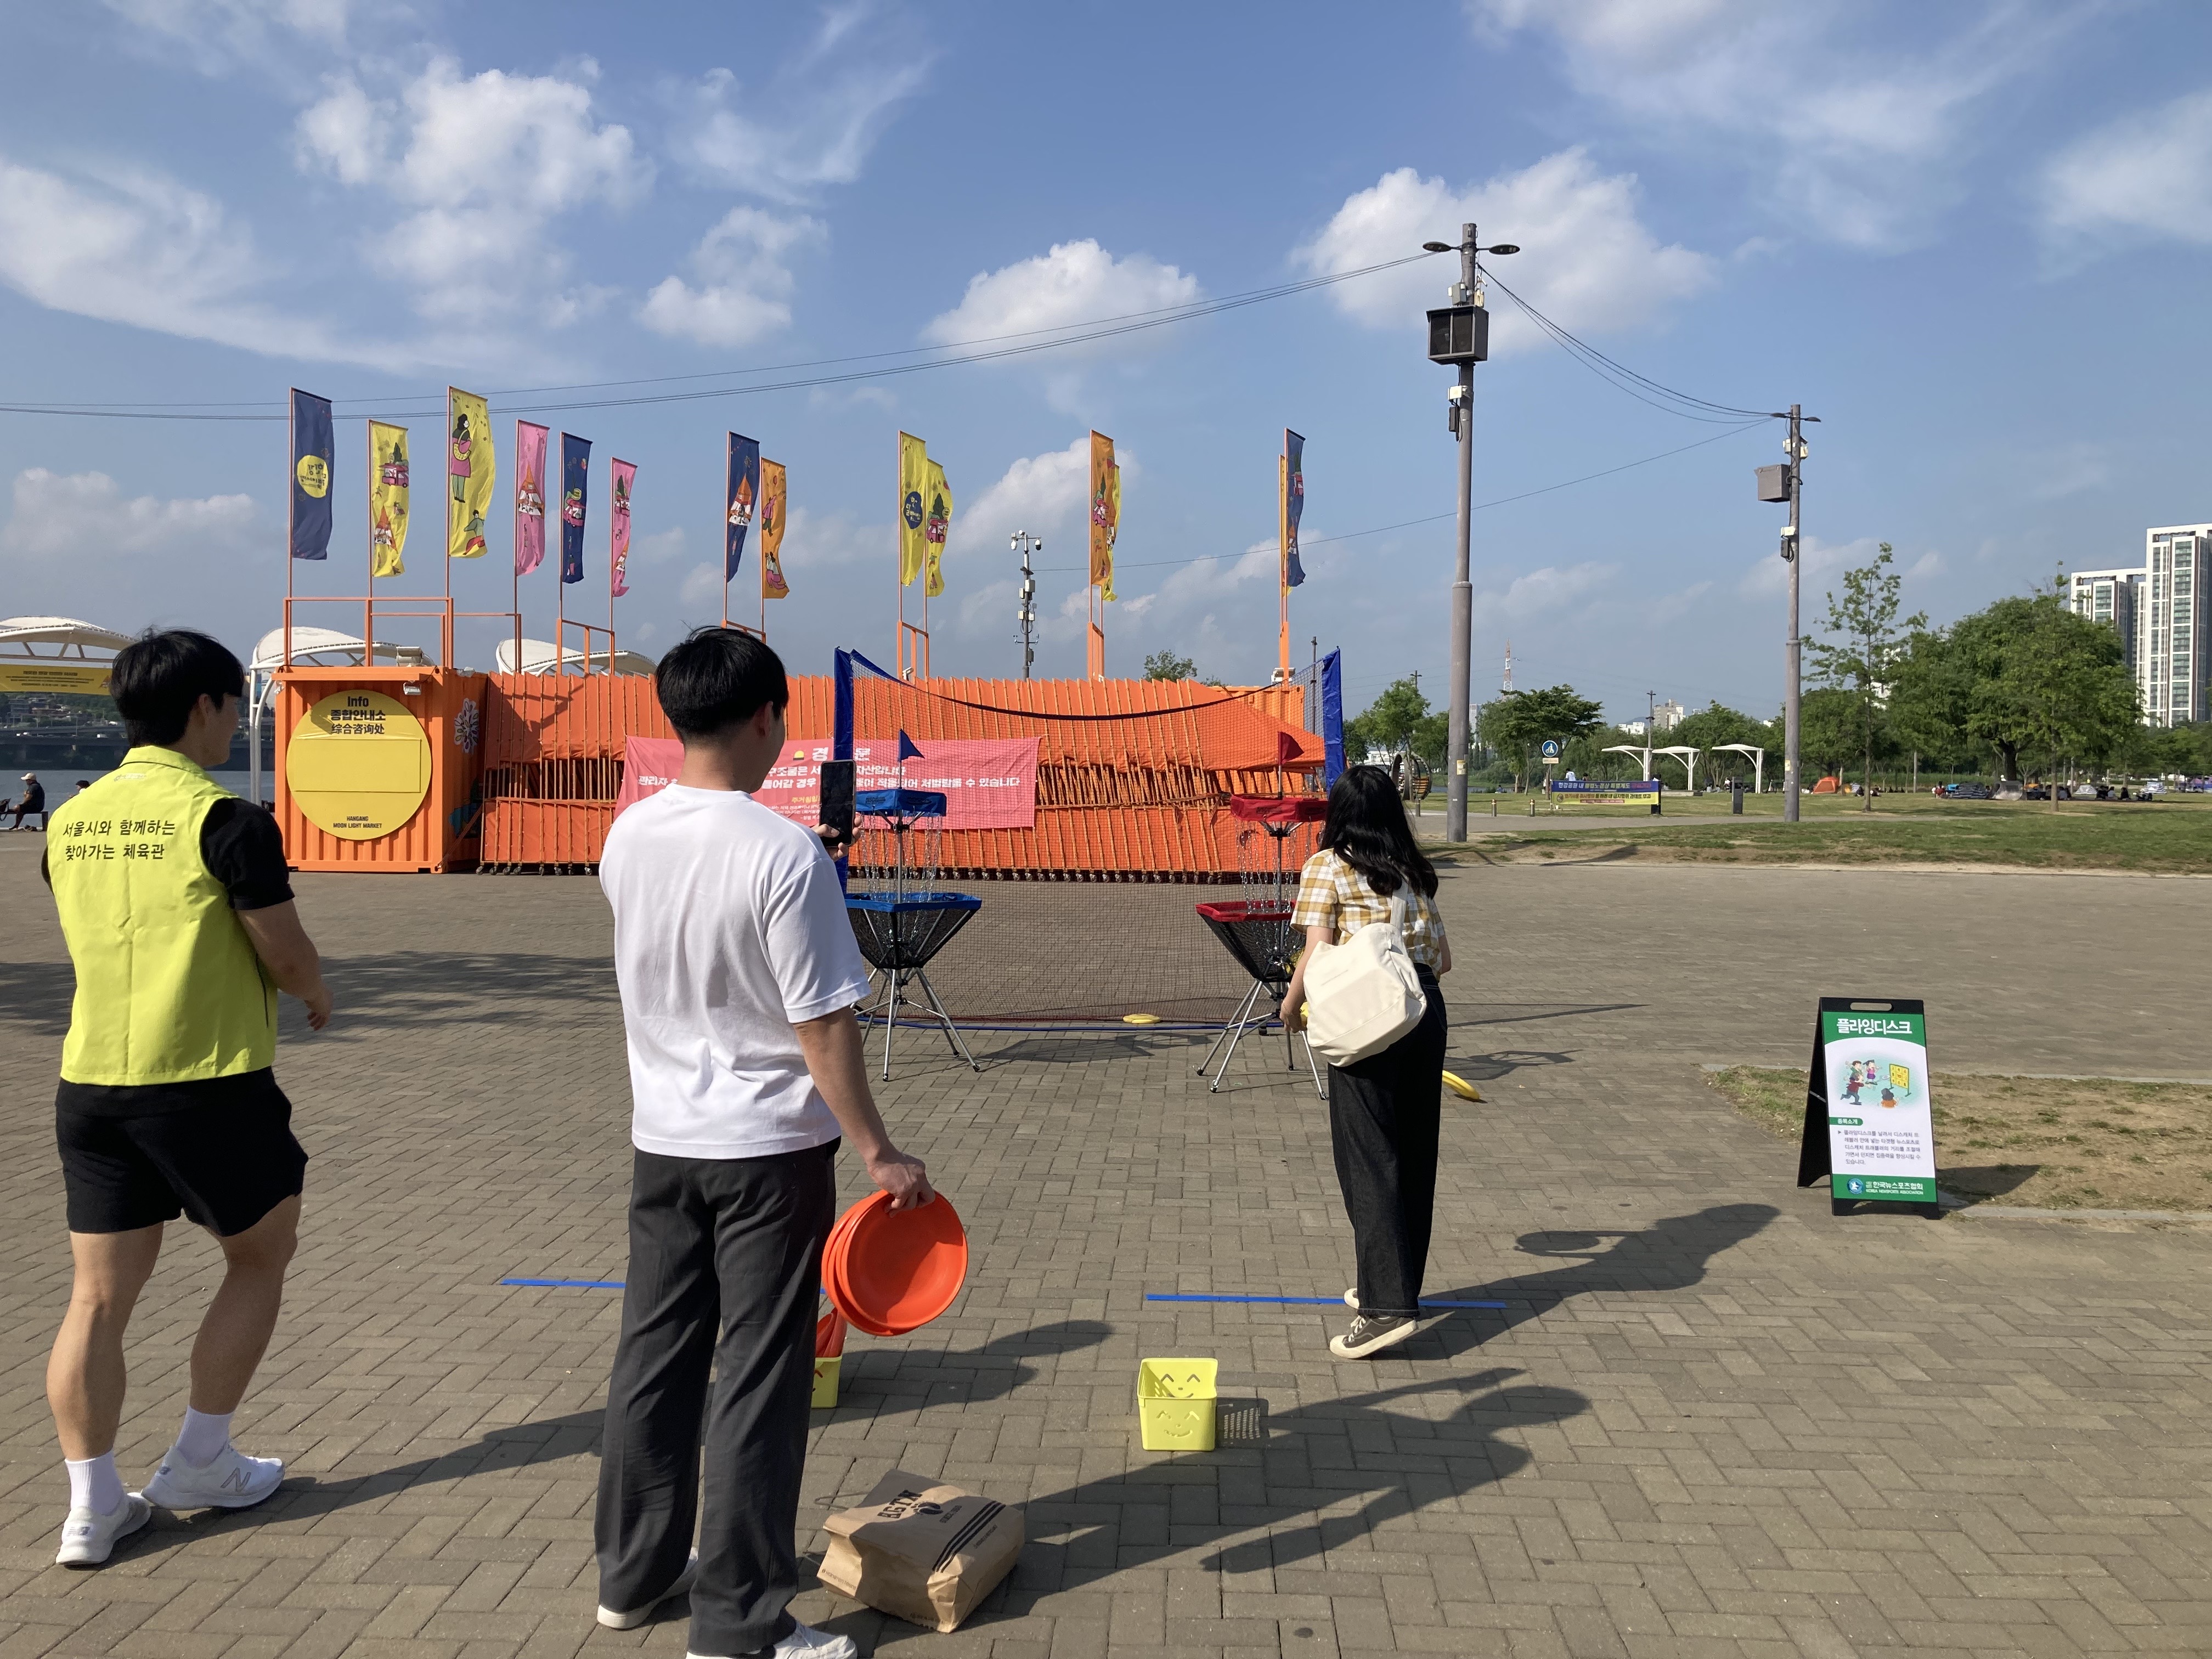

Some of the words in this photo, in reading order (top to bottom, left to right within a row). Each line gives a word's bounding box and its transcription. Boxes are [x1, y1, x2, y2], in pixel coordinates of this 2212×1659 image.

[347, 696, 369, 707] Info
[331, 709, 386, 721] 종합안내소
[331, 724, 385, 734] 综合咨询处
[639, 775, 668, 786] 관리자
[797, 778, 816, 788] 경우
[921, 777, 962, 788] 처벌받을
[966, 778, 975, 788] 수
[979, 777, 1020, 788] 있습니다
[63, 820, 112, 837] 서울시와
[120, 820, 176, 836] 함께하는
[65, 844, 115, 861] 찾아가는
[123, 843, 165, 860] 체육관
[1837, 1018, 1912, 1035] 플라잉디스크
[1873, 1181, 1923, 1190] 한국뉴스포츠협회
